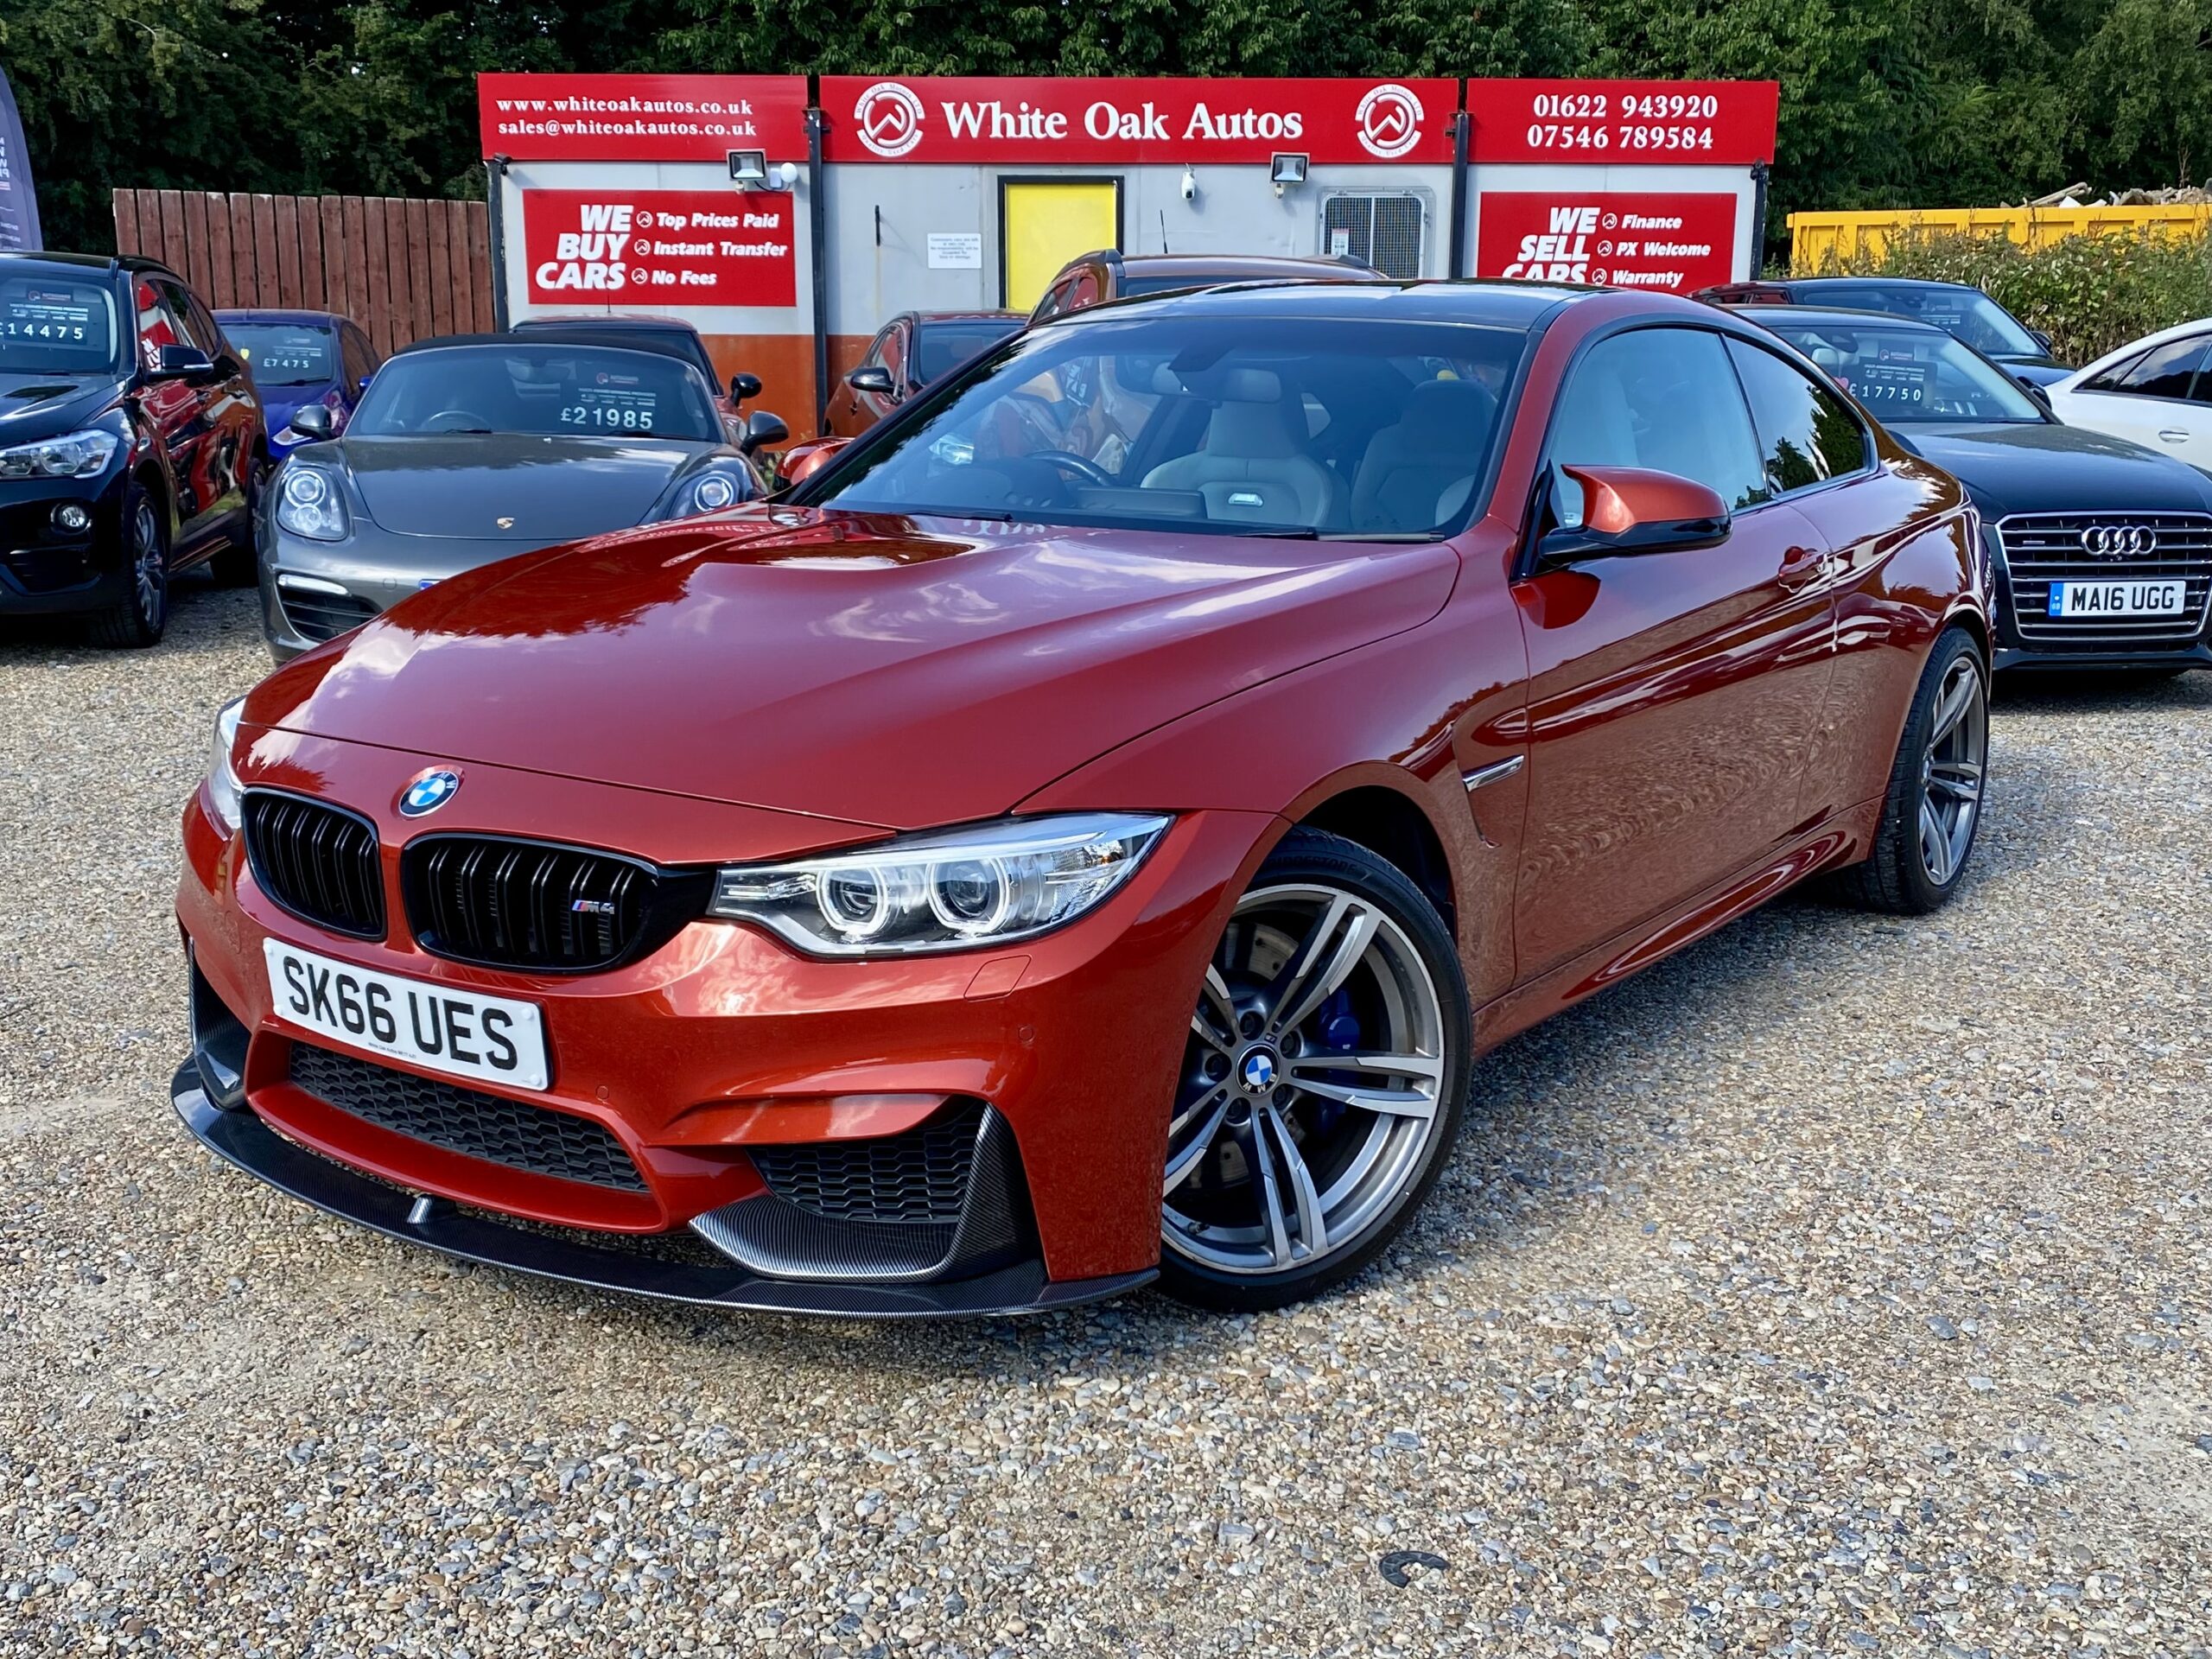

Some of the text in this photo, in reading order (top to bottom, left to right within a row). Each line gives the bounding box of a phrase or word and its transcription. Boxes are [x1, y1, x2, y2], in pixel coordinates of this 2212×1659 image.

[497, 97, 753, 115] www.whiteoakautos.co.uk
[1534, 95, 1718, 118] 01622 943920
[498, 119, 756, 137] sales@whiteoakautos.co.uk
[941, 100, 1303, 140] White Oak Autos
[1527, 124, 1713, 149] 07546 789584
[581, 205, 633, 232] WE
[657, 213, 779, 231] Top Prices Paid
[1549, 207, 1600, 234] WE
[1621, 214, 1683, 230] Finance
[556, 232, 631, 261] BUY
[653, 241, 788, 257] Instant Transfer
[1517, 235, 1591, 262] SELL
[1616, 242, 1712, 257] PX Welcome
[535, 262, 626, 290] CARS
[651, 270, 717, 285] No Fees
[1502, 263, 1587, 283] CARS
[1612, 270, 1684, 289] Warranty
[1849, 383, 1922, 401] £17750
[560, 406, 652, 429] £21985
[2071, 587, 2175, 611] MA16 UGG
[283, 956, 519, 1071] SK66 UES
